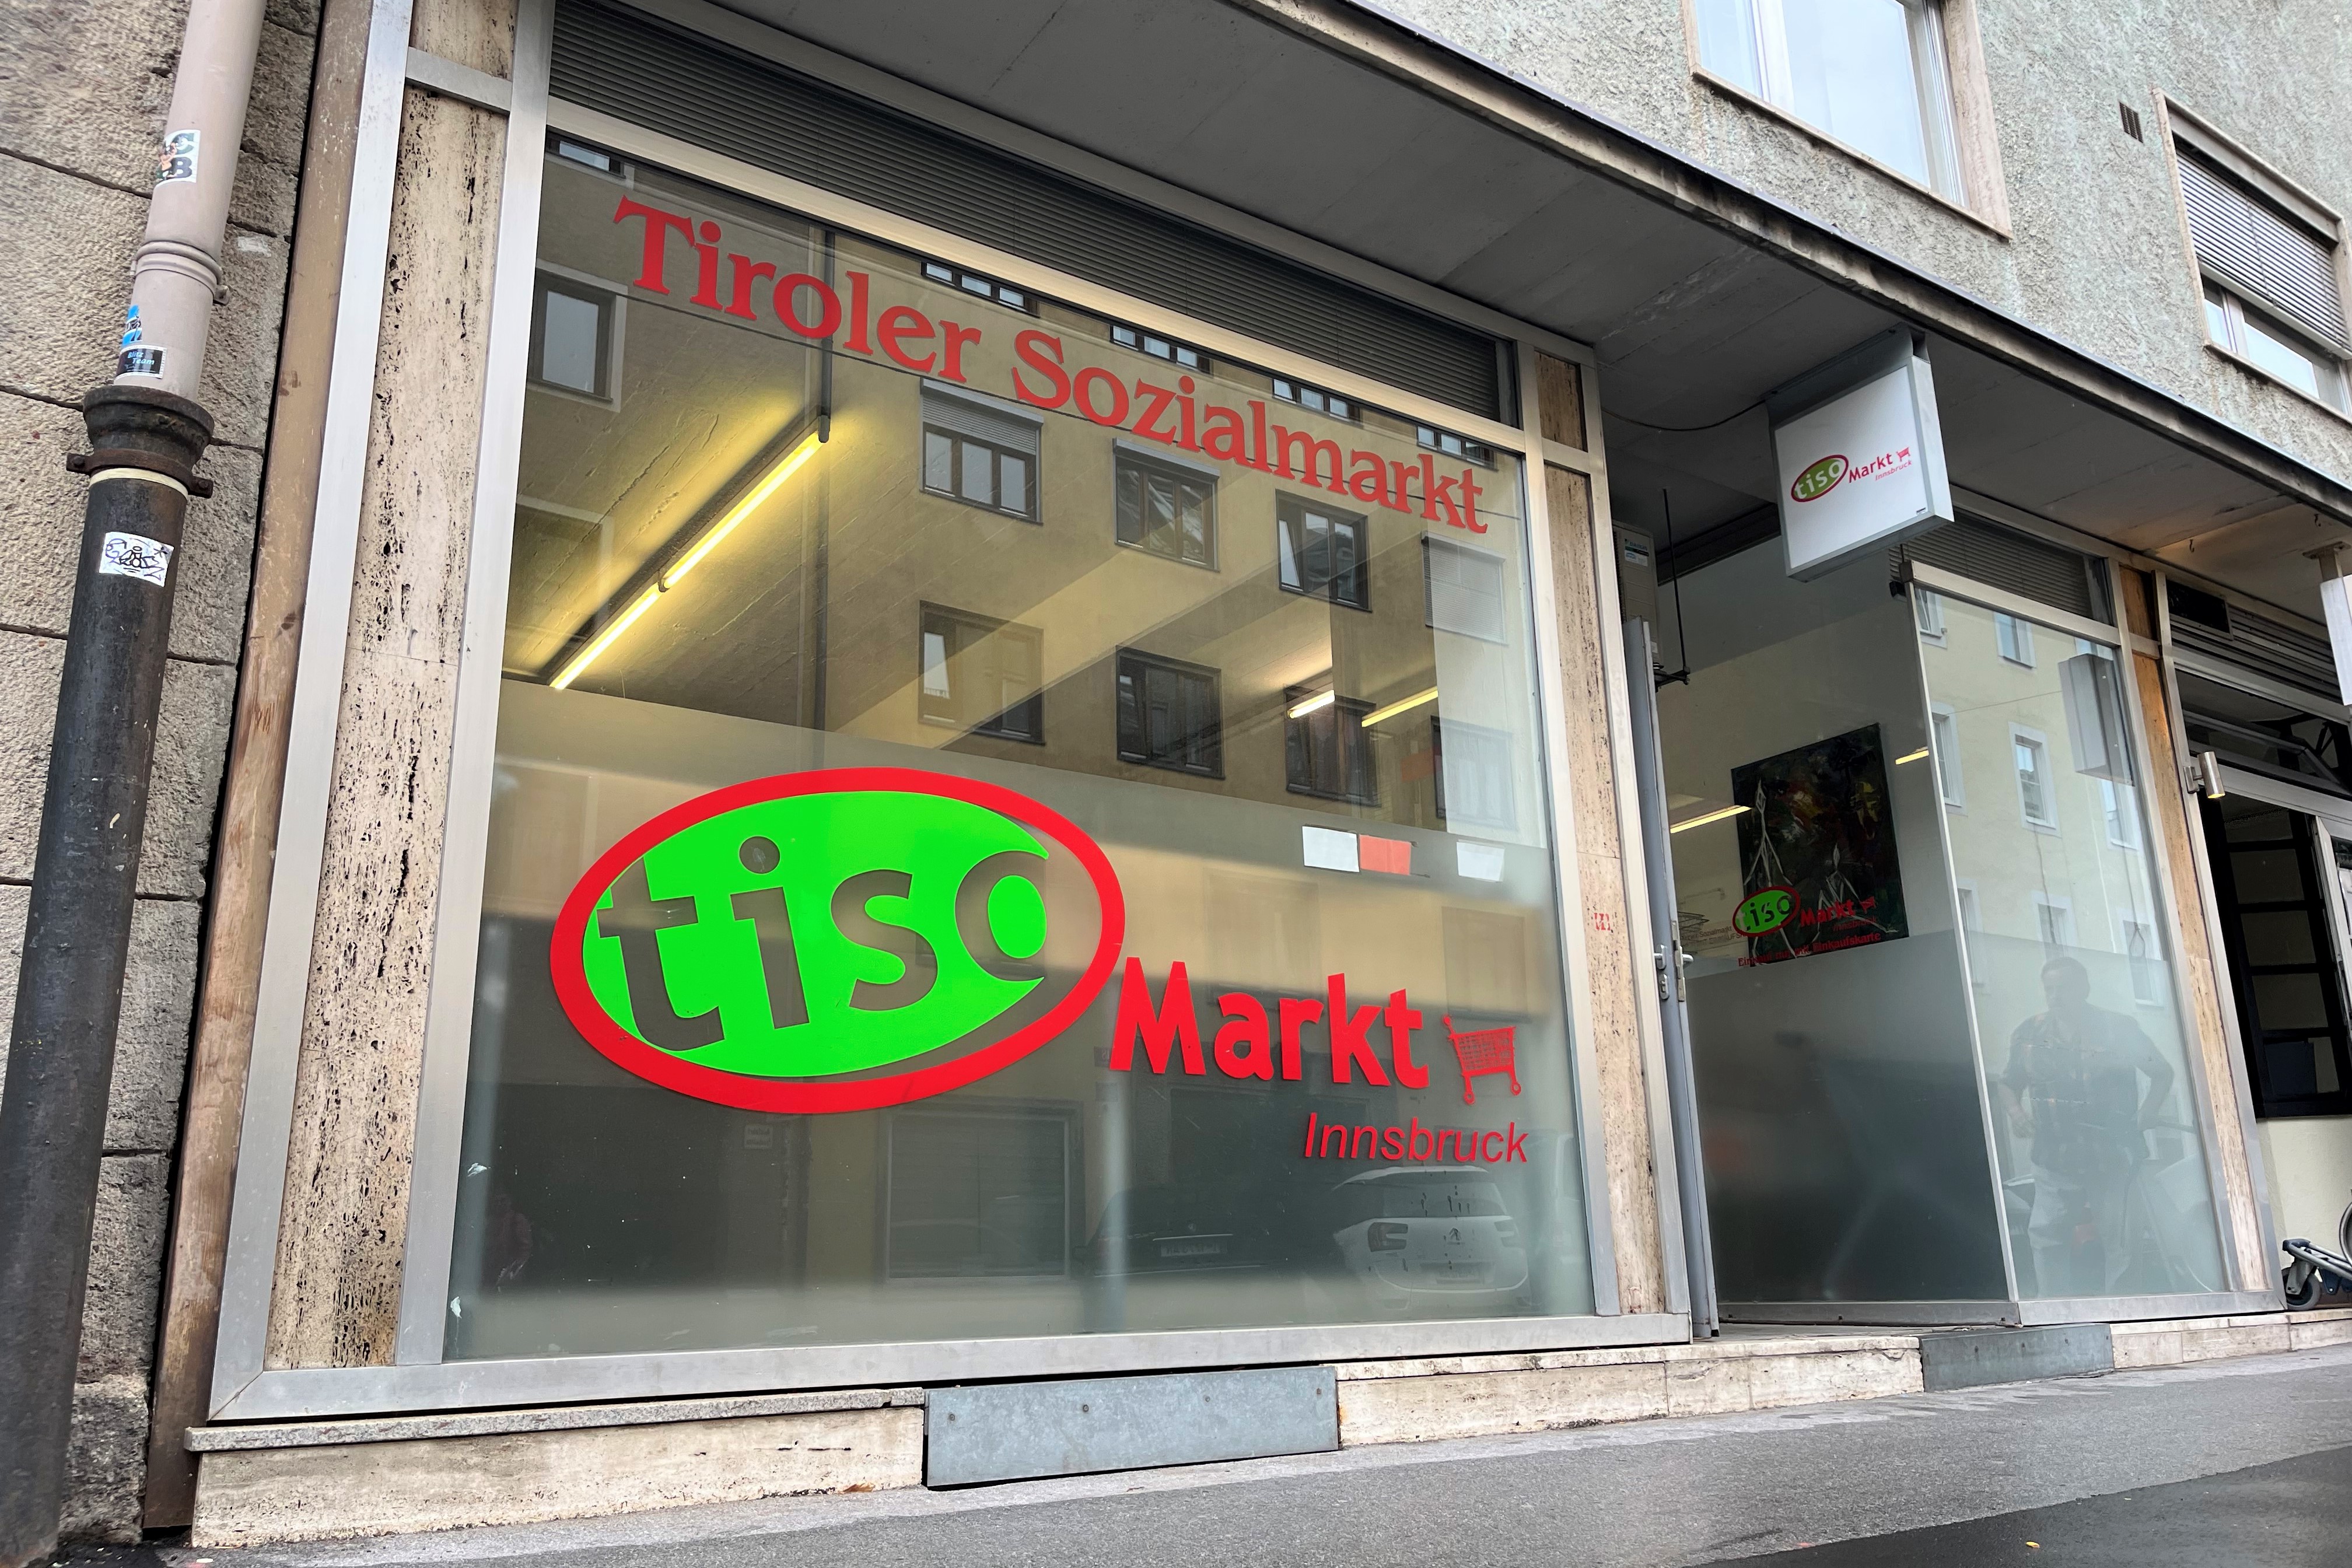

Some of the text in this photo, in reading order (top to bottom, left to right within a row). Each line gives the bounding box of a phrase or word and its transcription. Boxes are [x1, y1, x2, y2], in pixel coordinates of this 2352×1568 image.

[613, 195, 1489, 534] Tiroler Sozialmarkt
[1794, 452, 1893, 499] tiso Markt
[1874, 459, 1912, 481] Innsbruck
[1800, 898, 1857, 928] Markt
[595, 835, 1430, 1090] tiso Markt
[1304, 1112, 1529, 1163] Innsbruck
